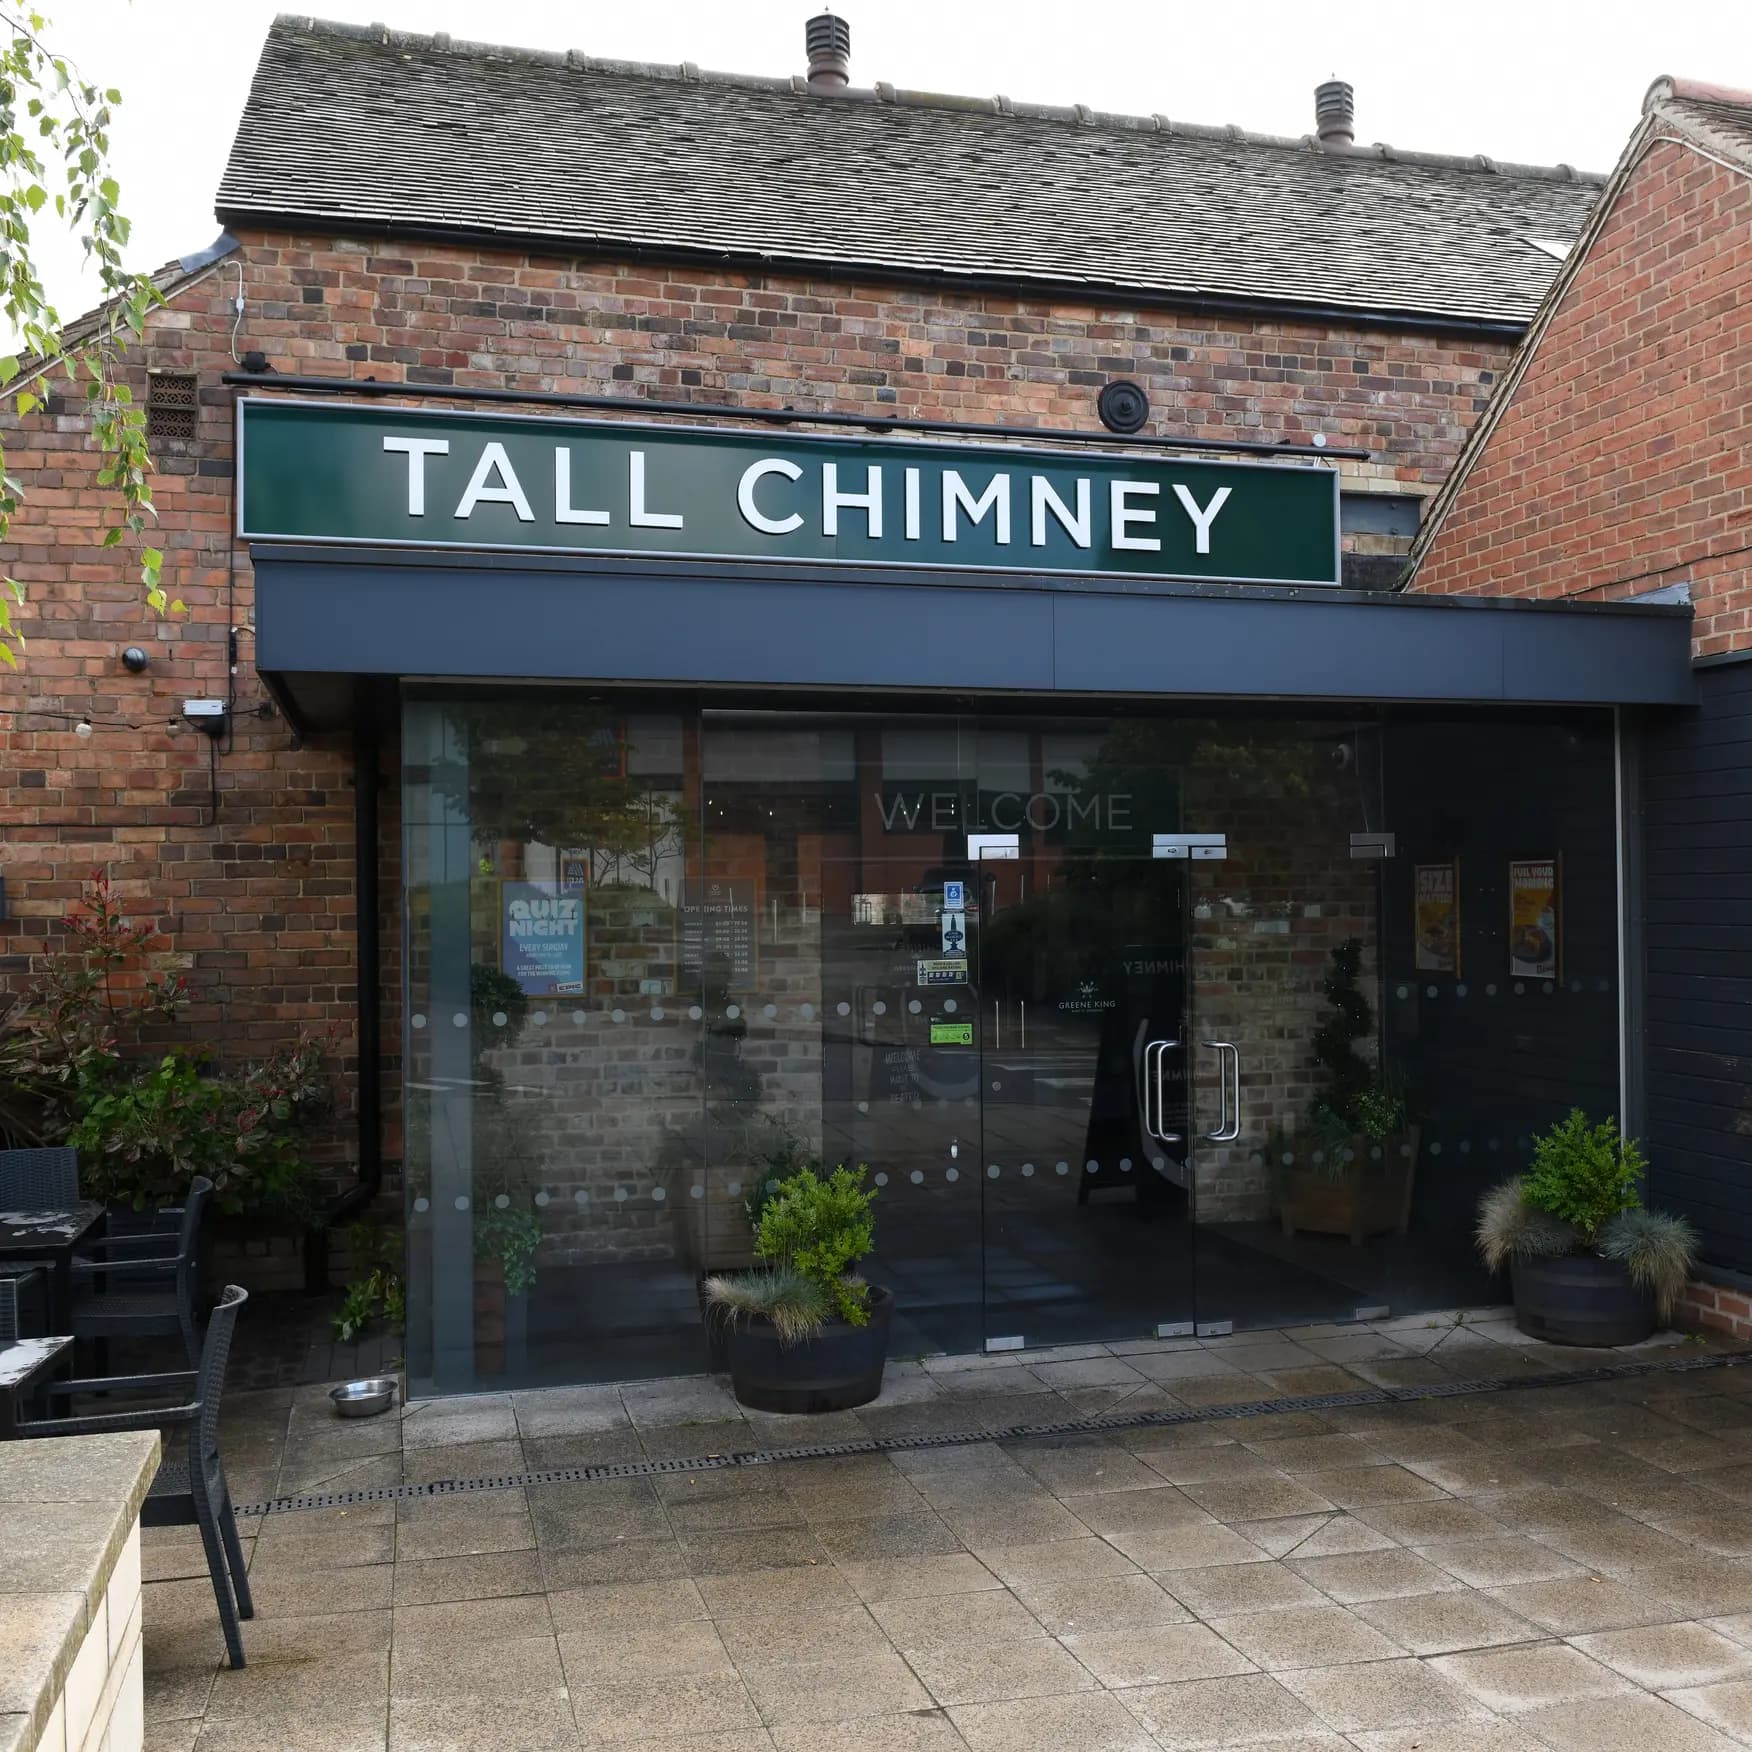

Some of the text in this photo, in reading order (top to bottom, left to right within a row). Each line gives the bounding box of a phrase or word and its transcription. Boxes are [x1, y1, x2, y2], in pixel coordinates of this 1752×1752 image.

[383, 436, 1232, 554] TALL CHIMNEY
[874, 792, 1134, 831] WELCOME
[509, 898, 577, 919] QUIZ
[683, 905, 721, 913] OPEING
[509, 920, 578, 937] NIGHT
[1058, 1000, 1116, 1009] GREENE KING
